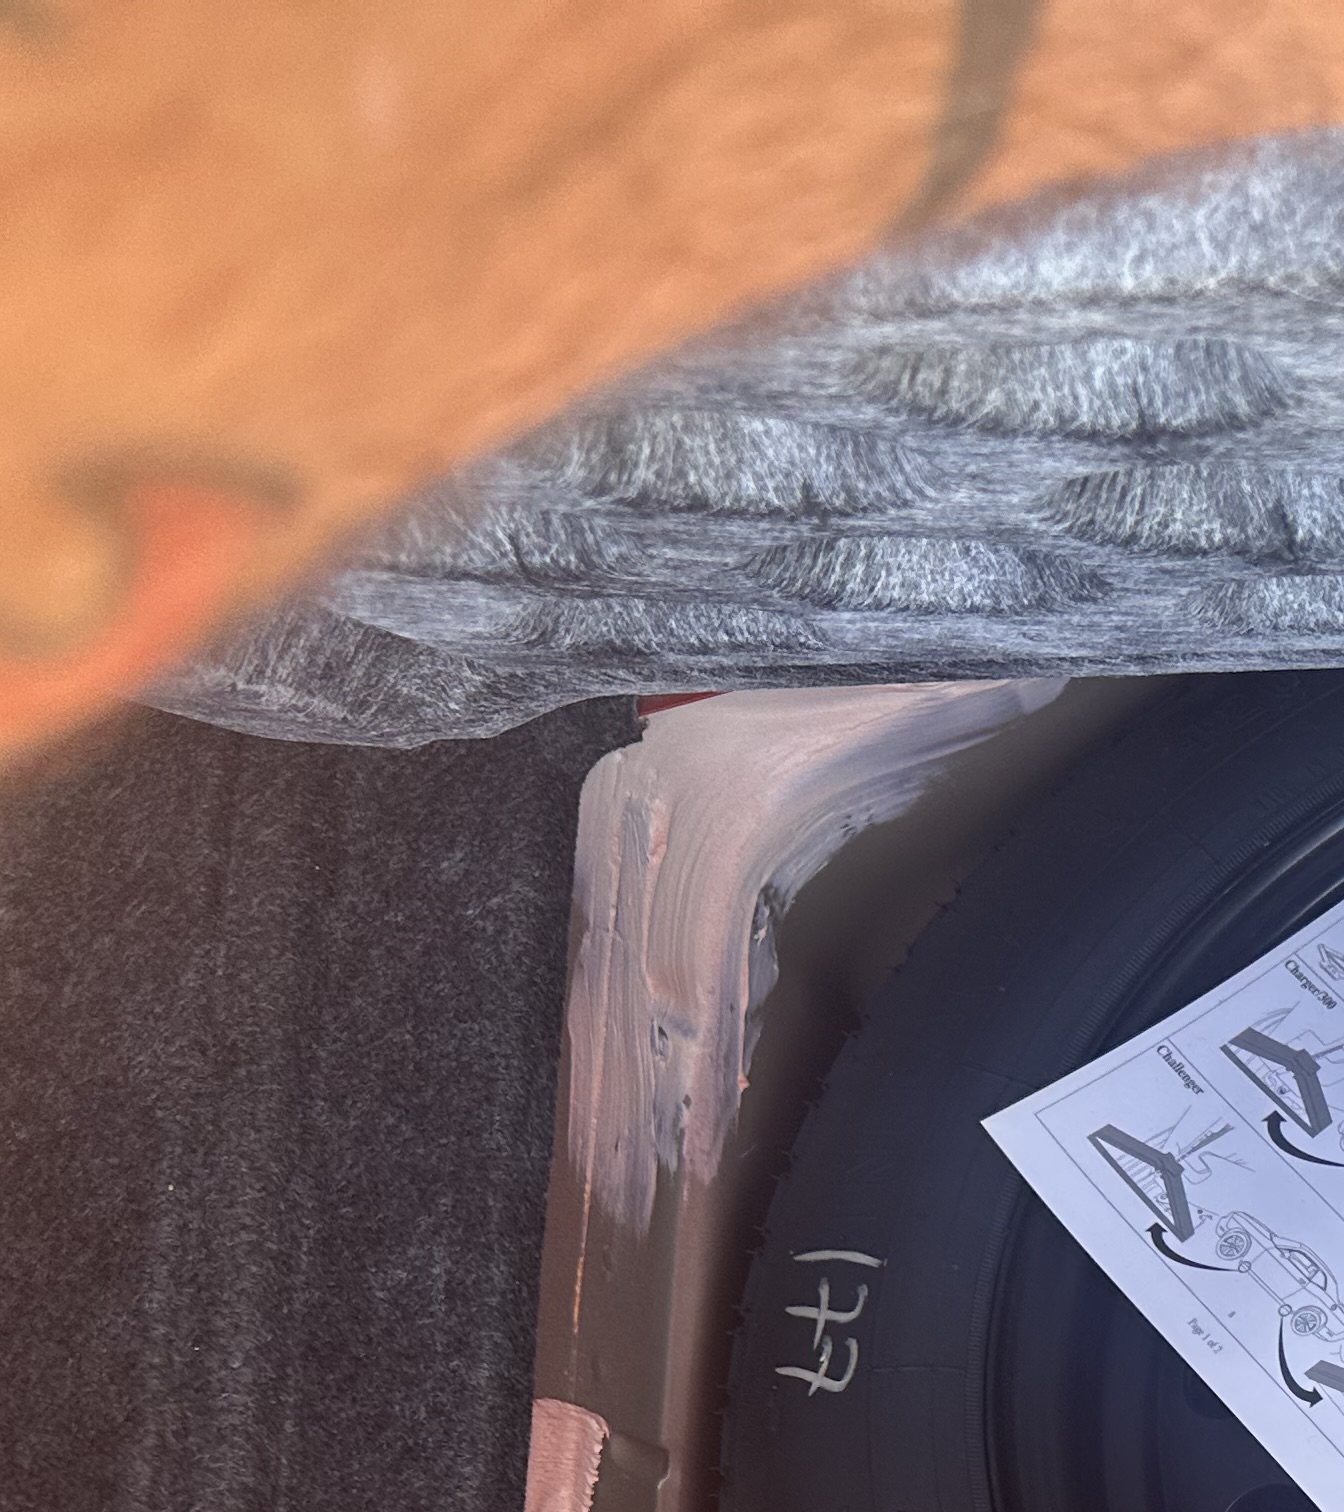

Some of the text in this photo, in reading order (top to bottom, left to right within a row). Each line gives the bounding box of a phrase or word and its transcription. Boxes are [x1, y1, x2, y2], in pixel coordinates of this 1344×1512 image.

[1281, 957, 1339, 1012] Charger/300
[1150, 1042, 1209, 1099] Challenger
[1184, 1316, 1208, 1339] Page
[1204, 1337, 1219, 1350] of
